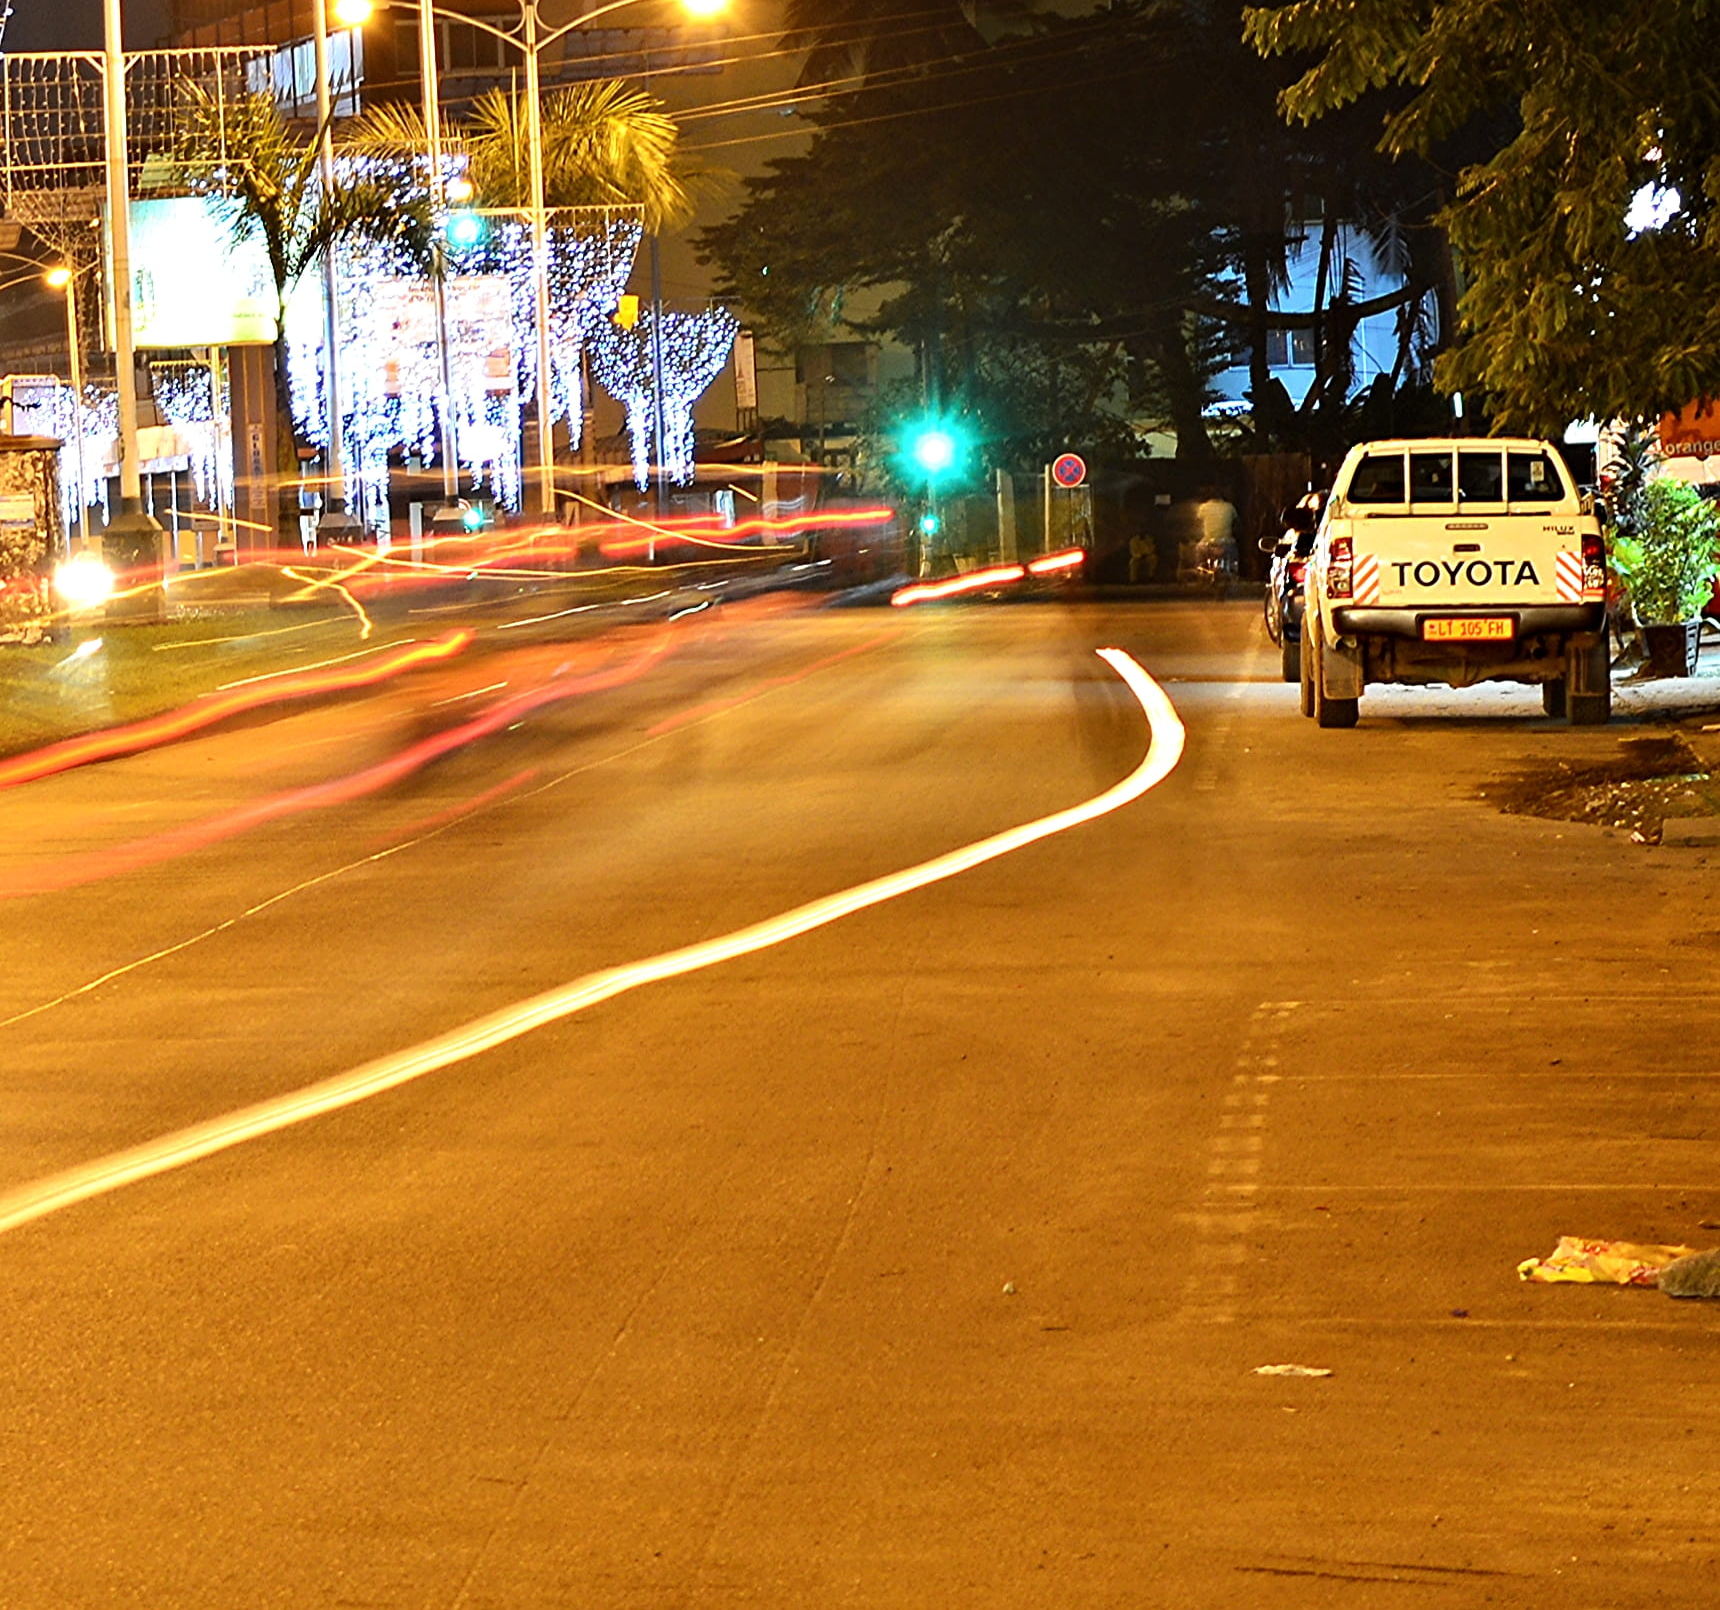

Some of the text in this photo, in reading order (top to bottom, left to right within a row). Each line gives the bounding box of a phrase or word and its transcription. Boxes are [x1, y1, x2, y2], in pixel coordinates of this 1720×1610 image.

[1665, 439, 1720, 456] orange
[1391, 561, 1540, 587] TOYOTA
[1460, 620, 1482, 636] 105
